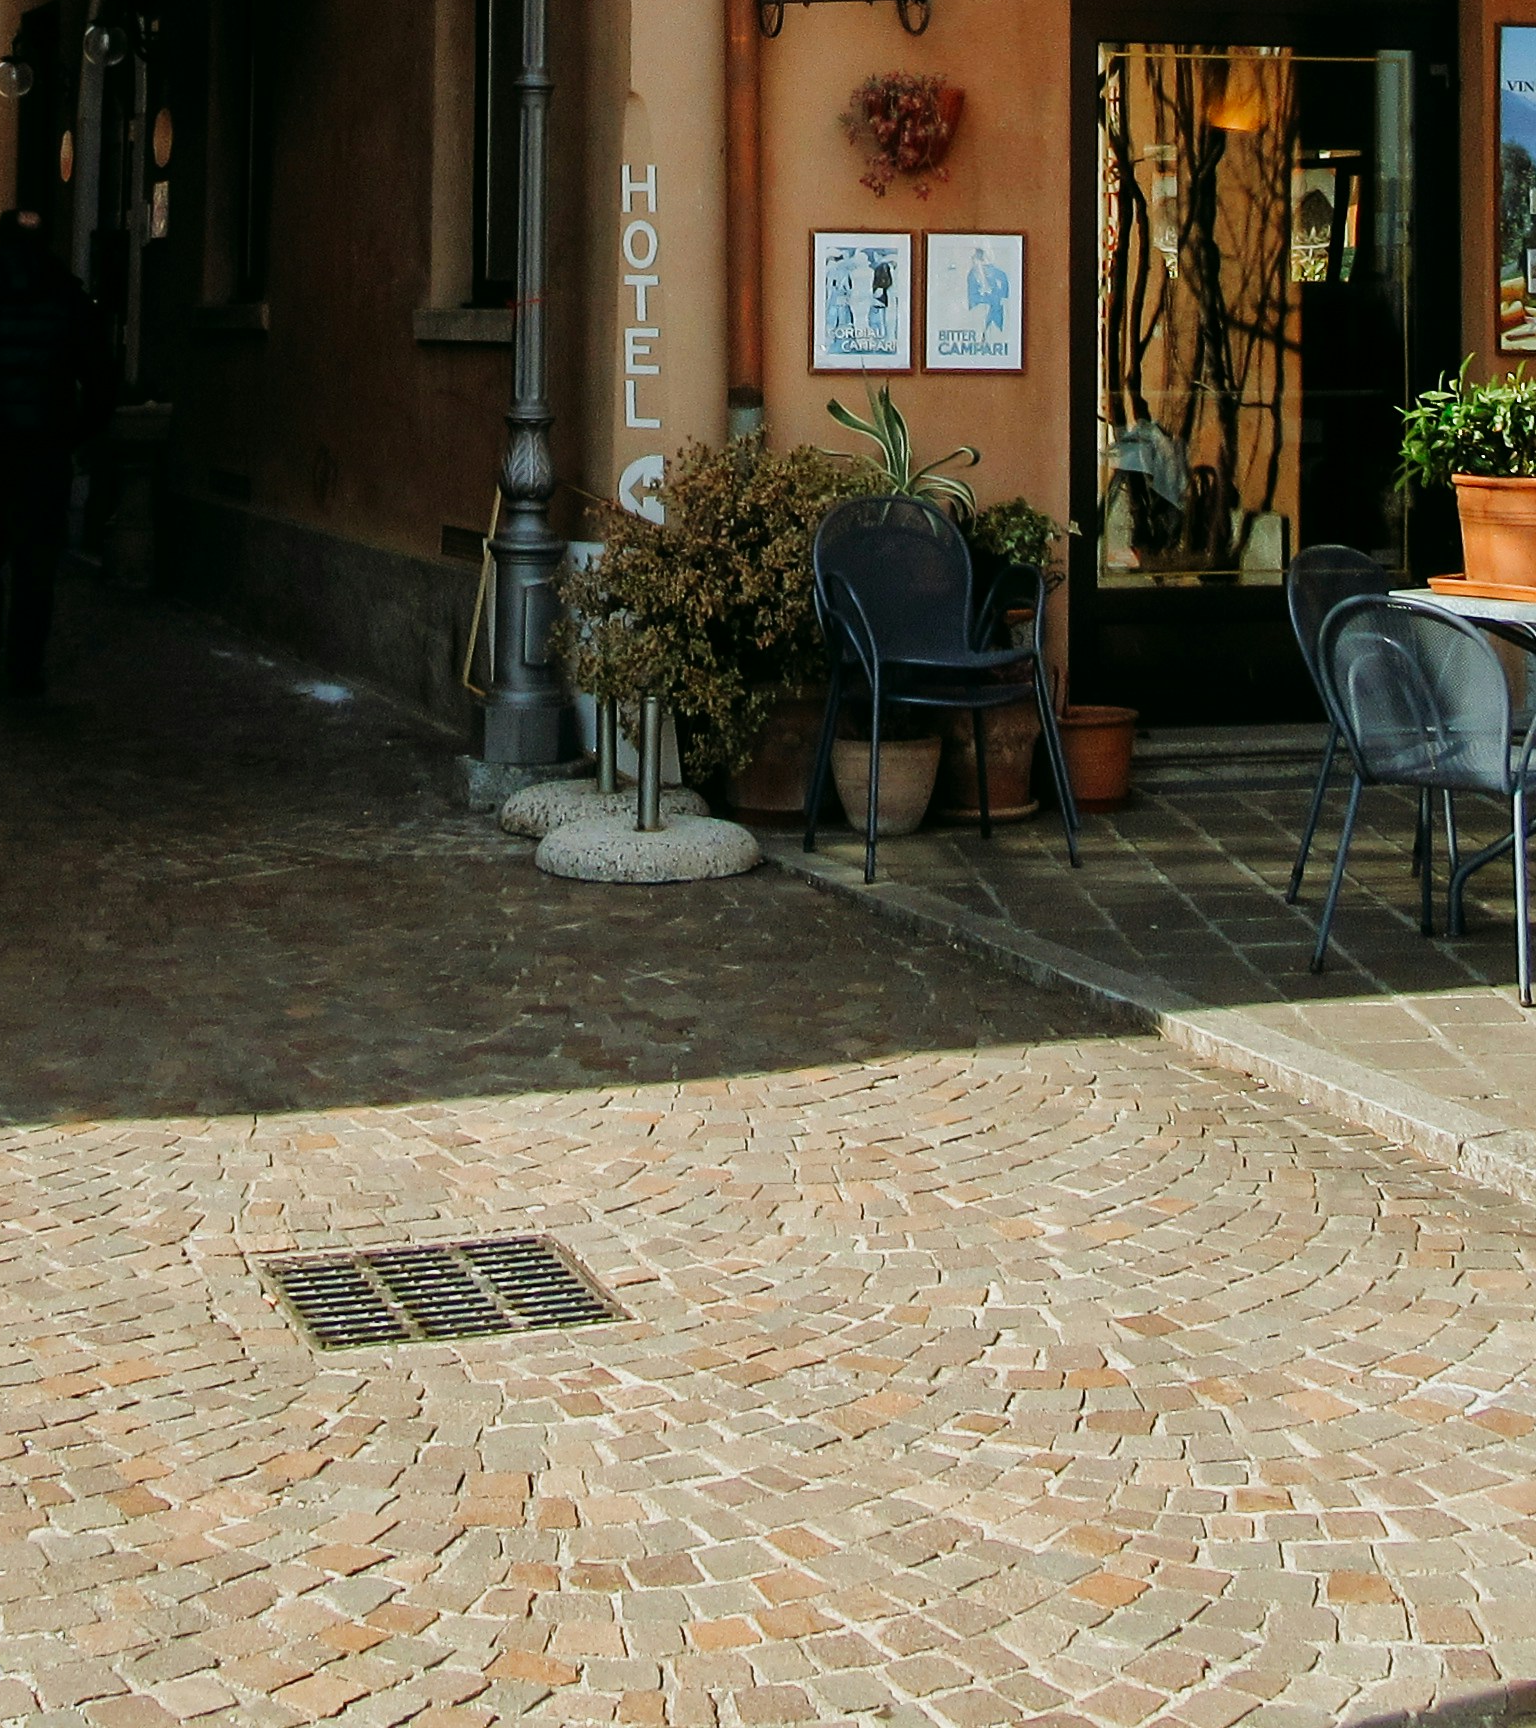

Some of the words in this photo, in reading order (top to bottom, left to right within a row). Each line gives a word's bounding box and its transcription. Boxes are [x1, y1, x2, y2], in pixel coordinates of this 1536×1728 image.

[621, 164, 661, 429] HOTEL
[938, 329, 977, 341] BITTER
[938, 341, 1009, 356] CAMPARI
